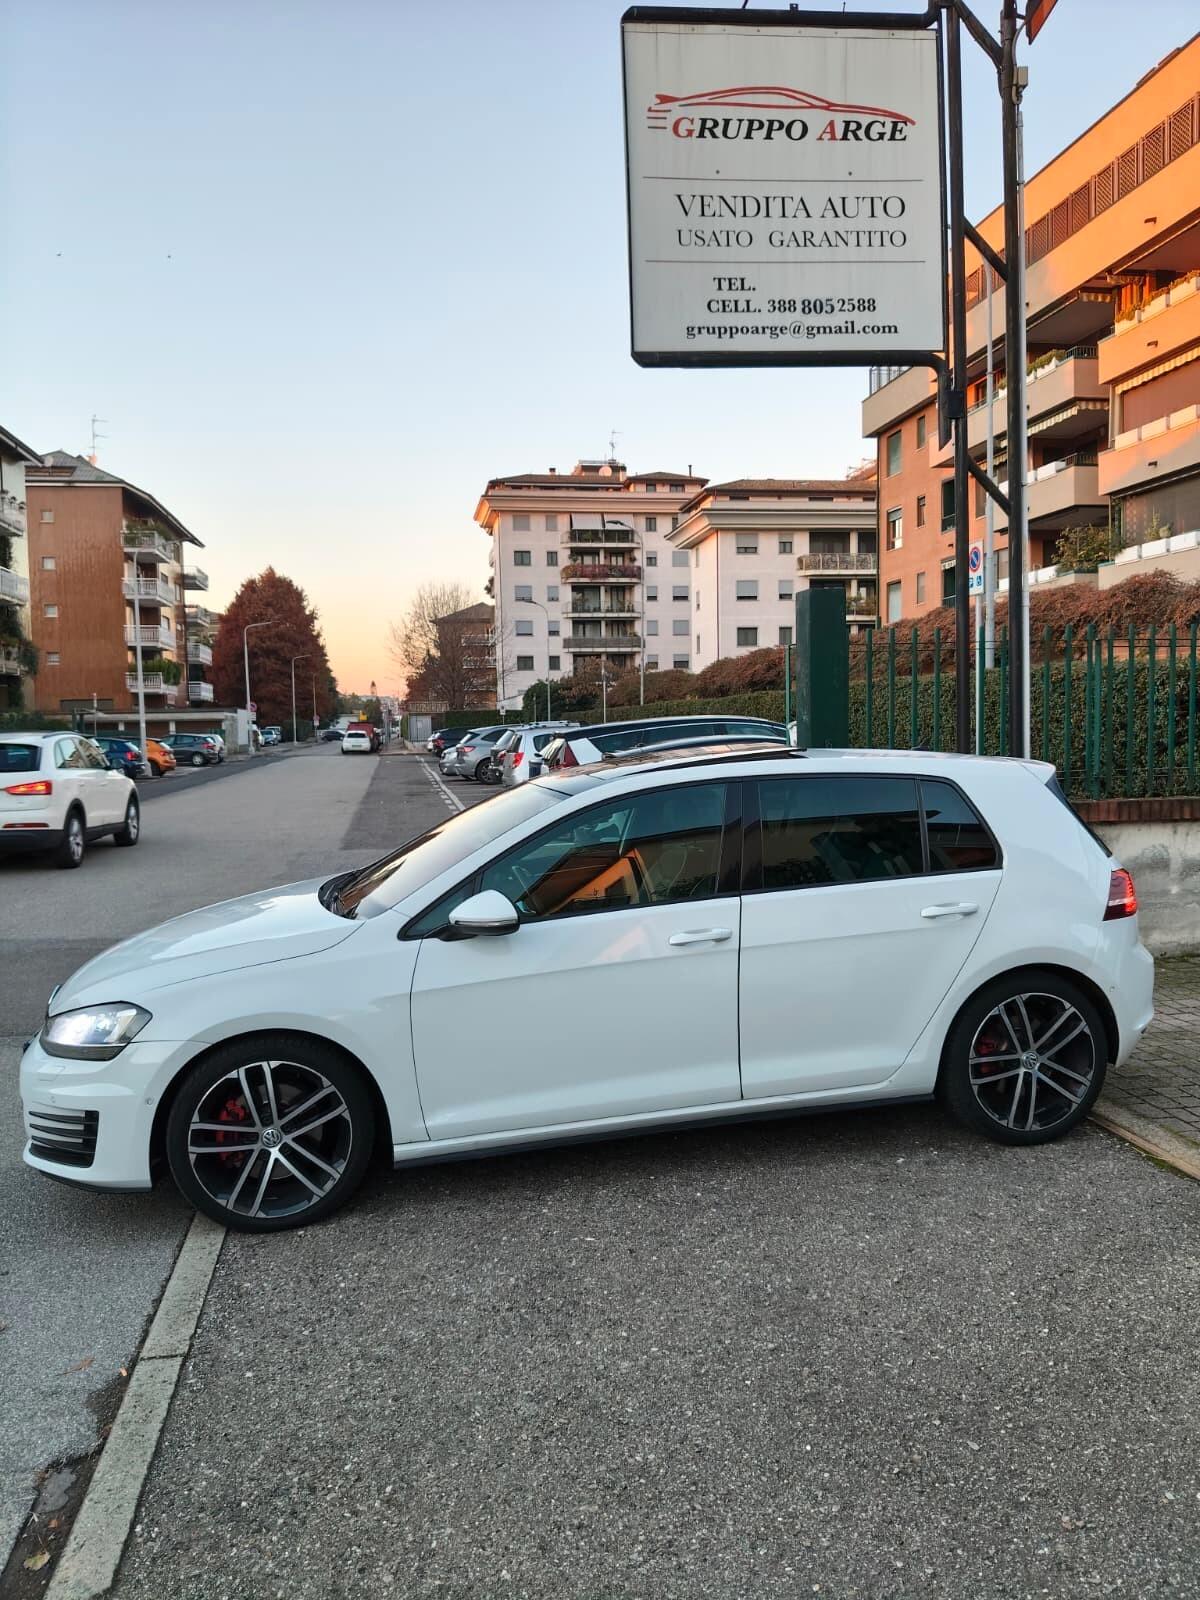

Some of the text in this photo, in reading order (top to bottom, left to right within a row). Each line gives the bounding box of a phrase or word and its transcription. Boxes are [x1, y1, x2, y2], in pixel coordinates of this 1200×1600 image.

[671, 116, 909, 142] GRUPPO ARGE
[674, 193, 907, 219] VENDITA AUTO
[676, 228, 908, 248] USATO GARANTITO
[712, 277, 757, 292] TEL.
[706, 299, 762, 314] CELL.
[767, 299, 798, 314] 388
[686, 320, 899, 340] gruppoarge@gmail.com
